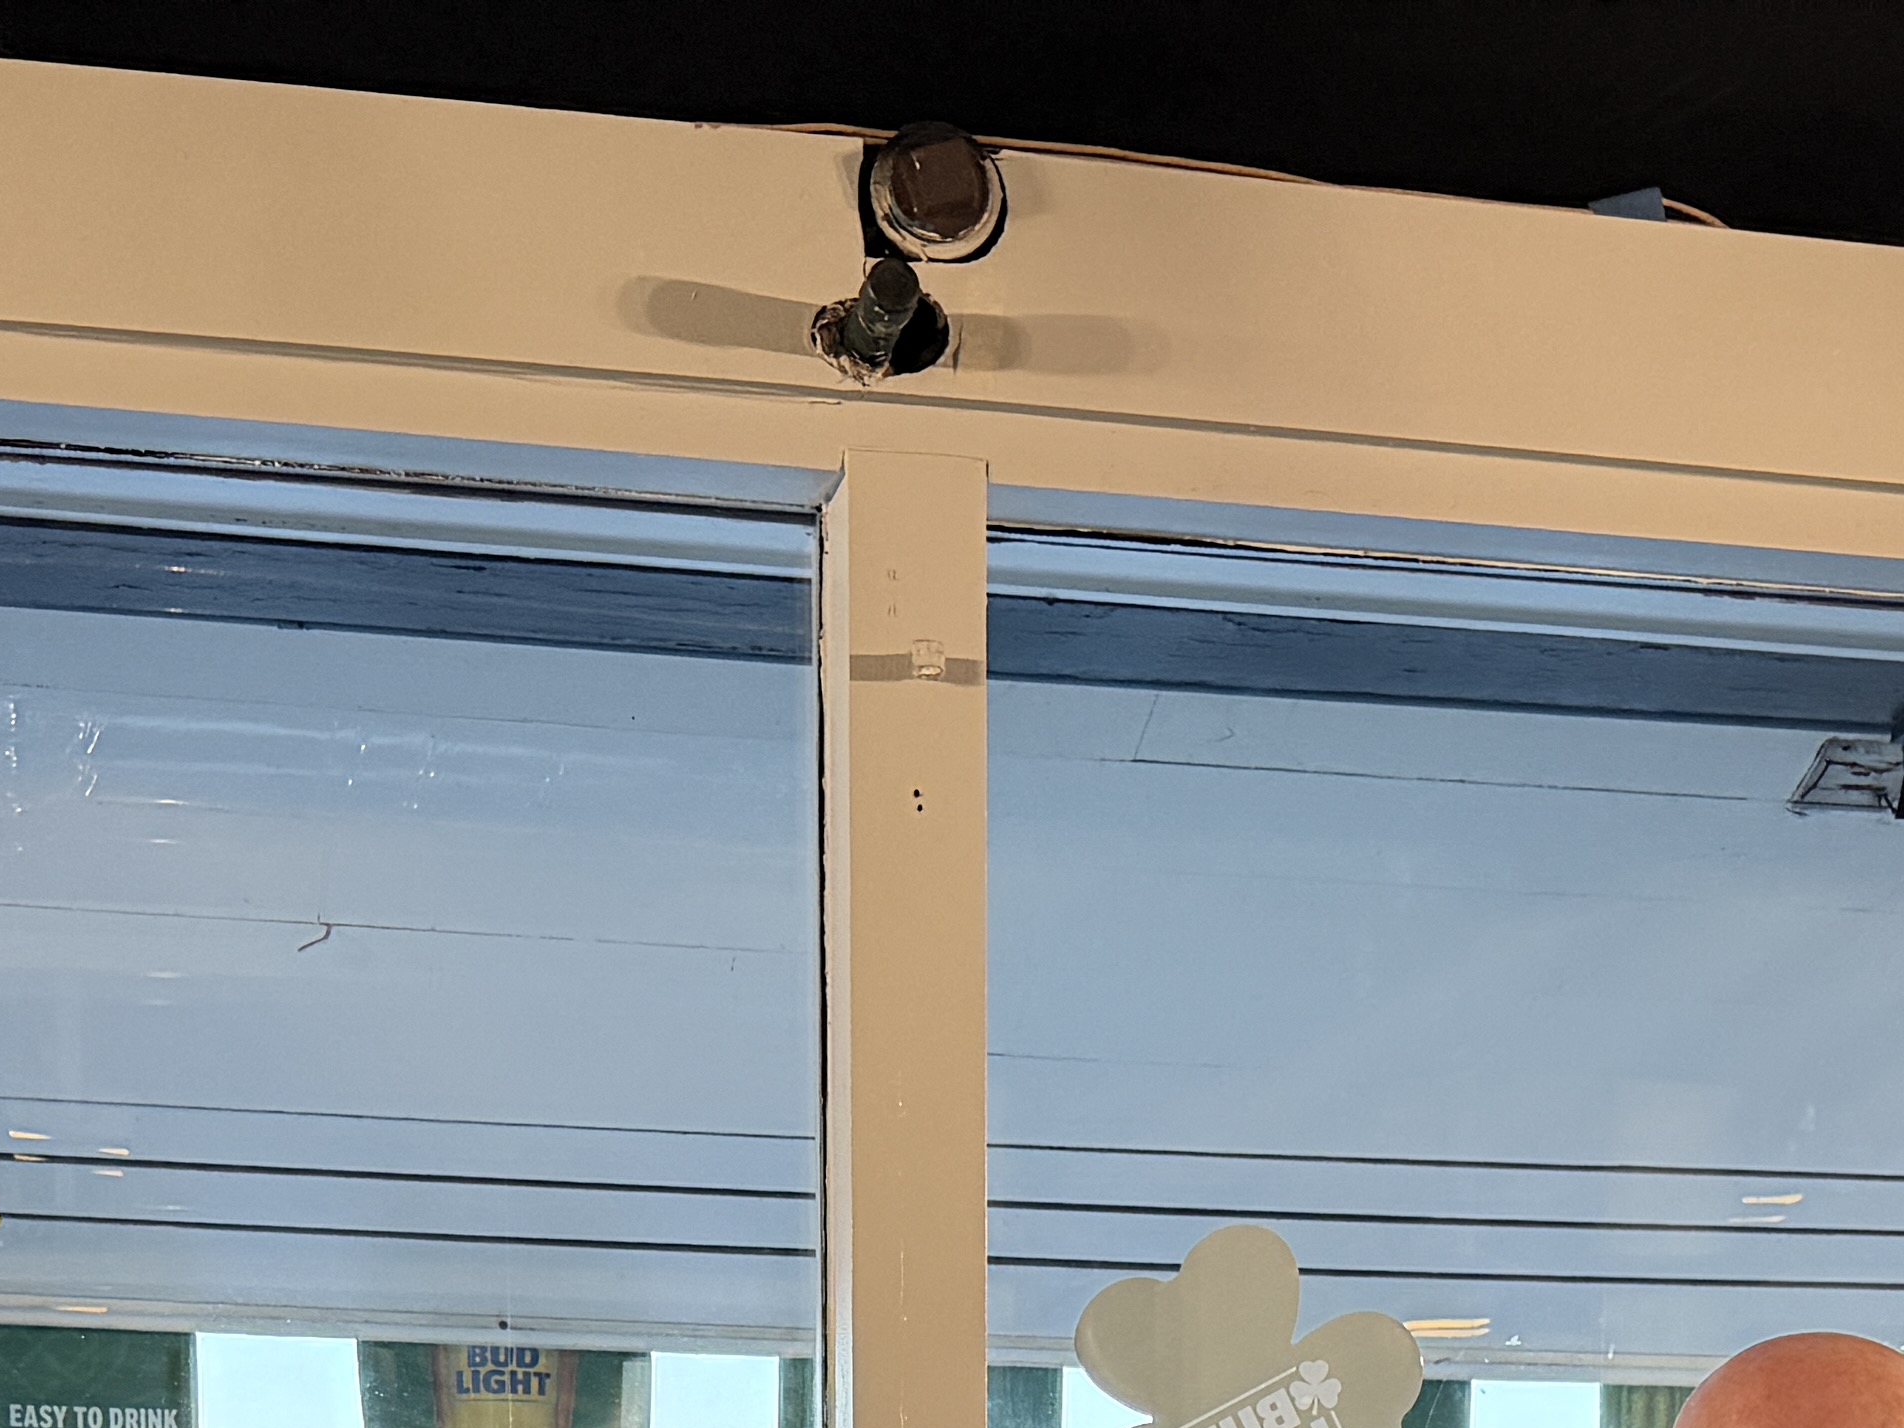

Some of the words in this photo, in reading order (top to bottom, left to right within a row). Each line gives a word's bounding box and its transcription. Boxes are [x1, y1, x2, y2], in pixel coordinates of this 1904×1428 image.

[467, 1346, 539, 1369] BUD
[456, 1369, 551, 1396] LIGHT
[9, 1404, 67, 1428] EASY
